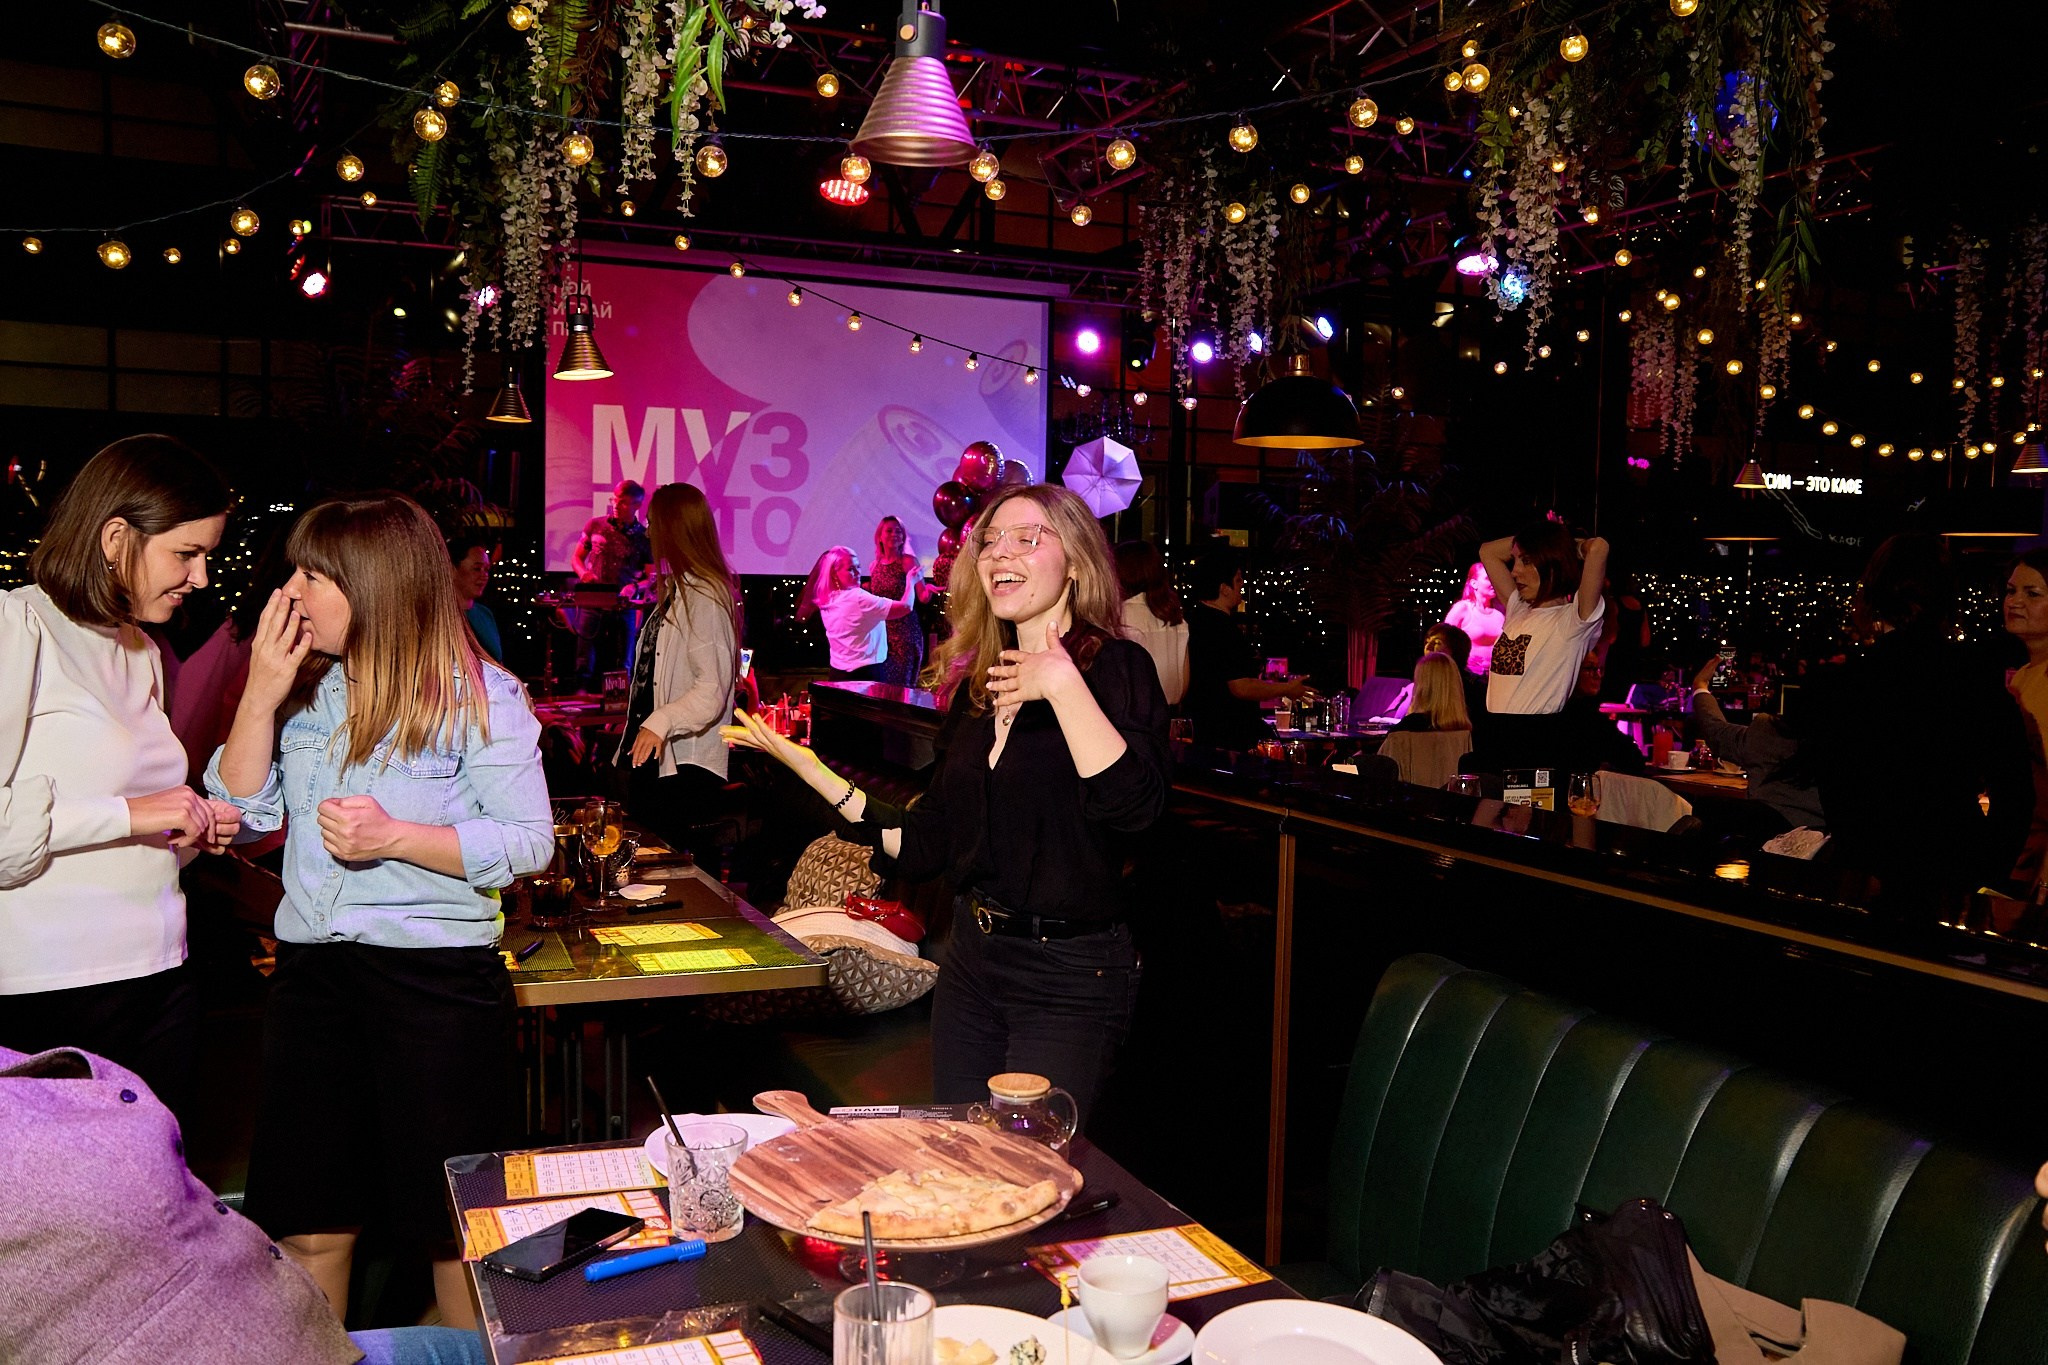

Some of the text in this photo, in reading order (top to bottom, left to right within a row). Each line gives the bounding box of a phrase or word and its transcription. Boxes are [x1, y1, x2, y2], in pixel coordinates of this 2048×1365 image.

[592, 403, 810, 498] МУЗ
[1806, 475, 1830, 492] ЭТО
[1831, 477, 1863, 494] КАФЕ
